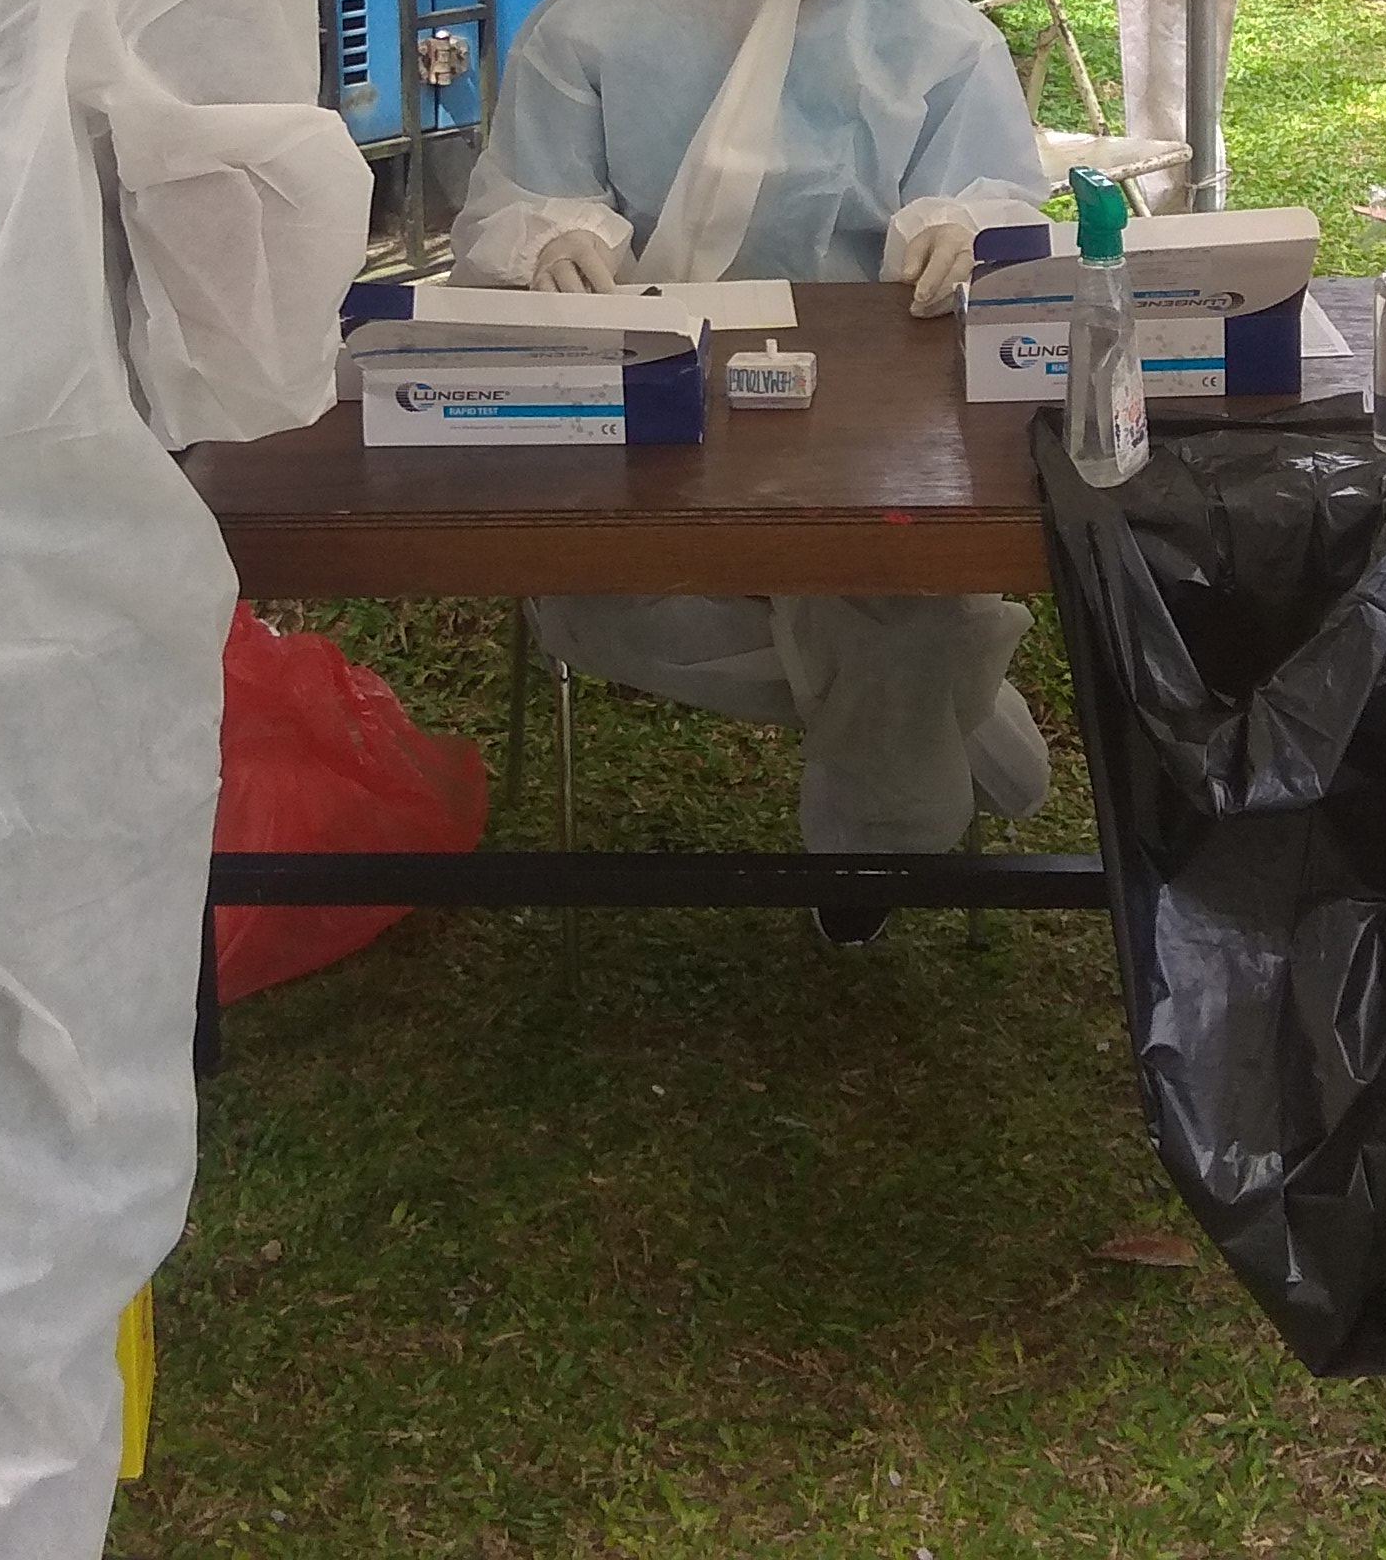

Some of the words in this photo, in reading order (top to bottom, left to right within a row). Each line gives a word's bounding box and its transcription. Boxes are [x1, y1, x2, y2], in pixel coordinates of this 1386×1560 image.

[1017, 345, 1069, 357] LUNG
[449, 407, 477, 416] RAPID
[480, 407, 499, 416] TEST
